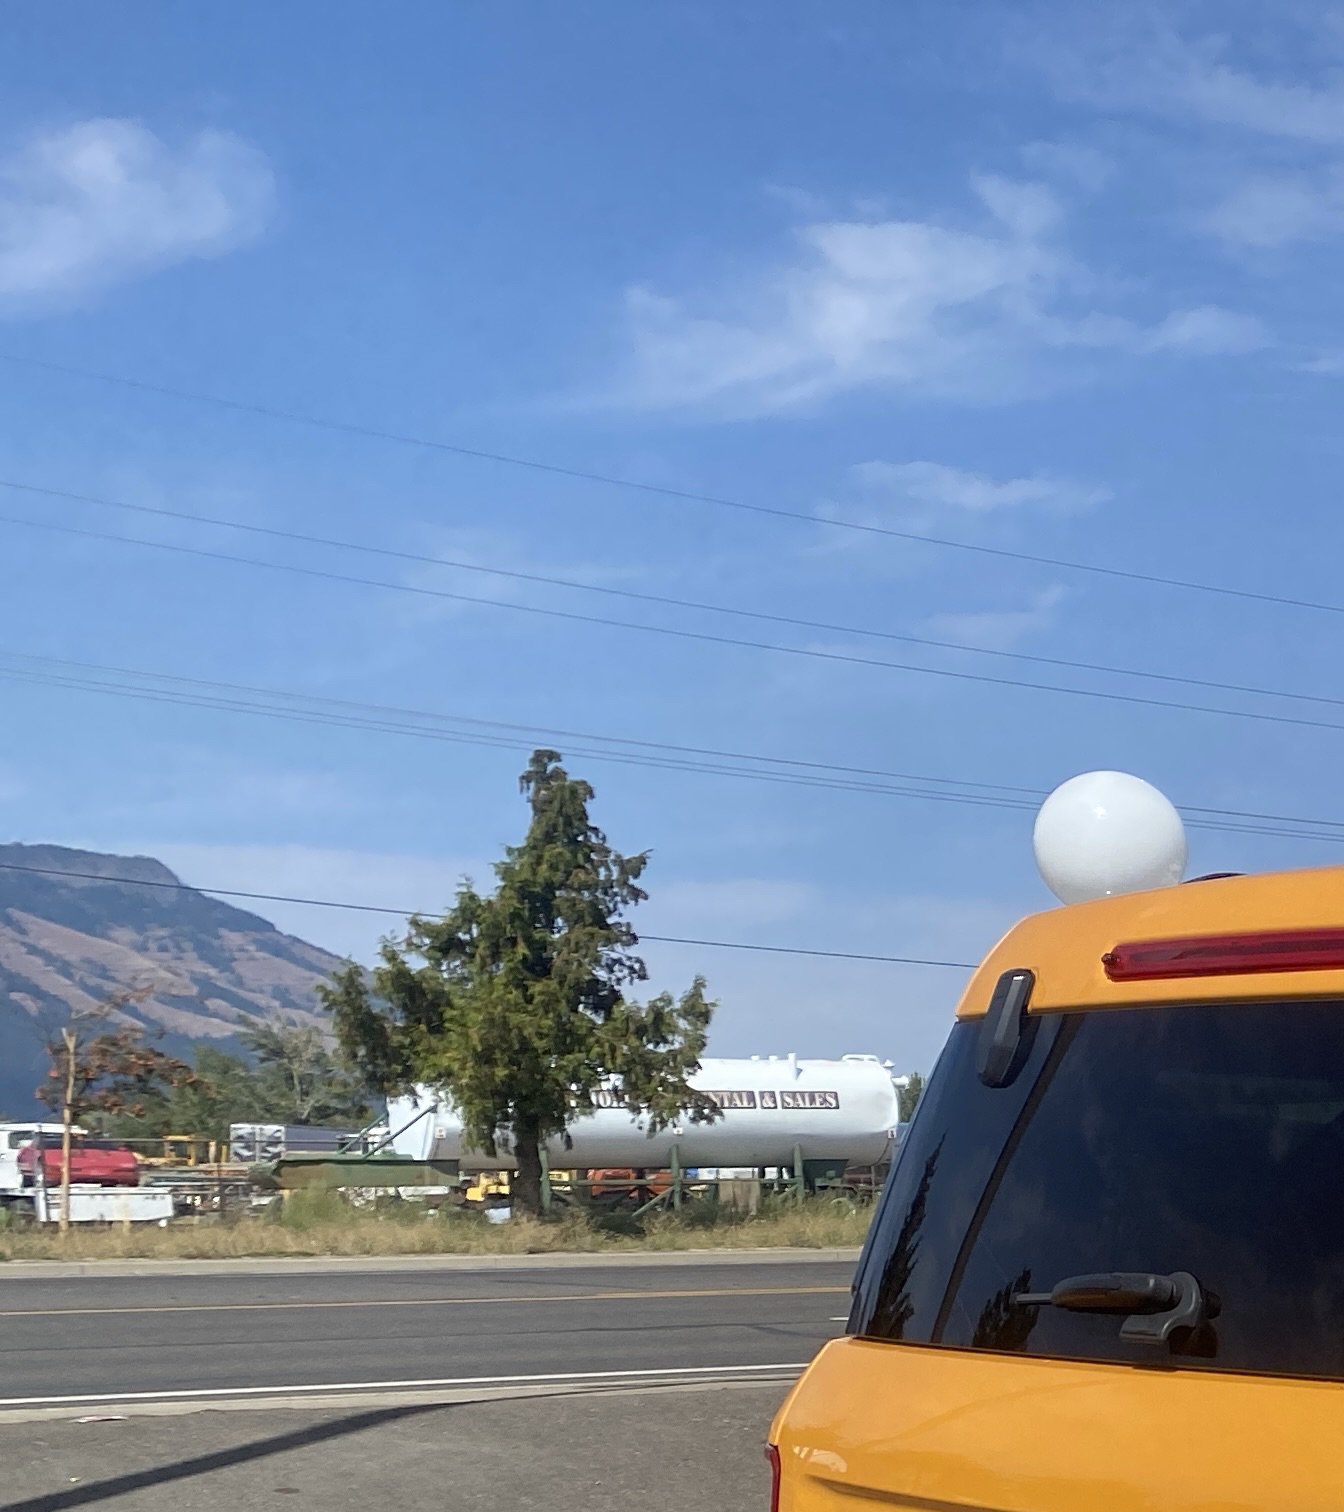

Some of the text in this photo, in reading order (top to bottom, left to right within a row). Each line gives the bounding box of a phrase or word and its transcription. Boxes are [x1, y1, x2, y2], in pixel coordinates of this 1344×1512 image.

[704, 1092, 838, 1108] NTAL & SALES
